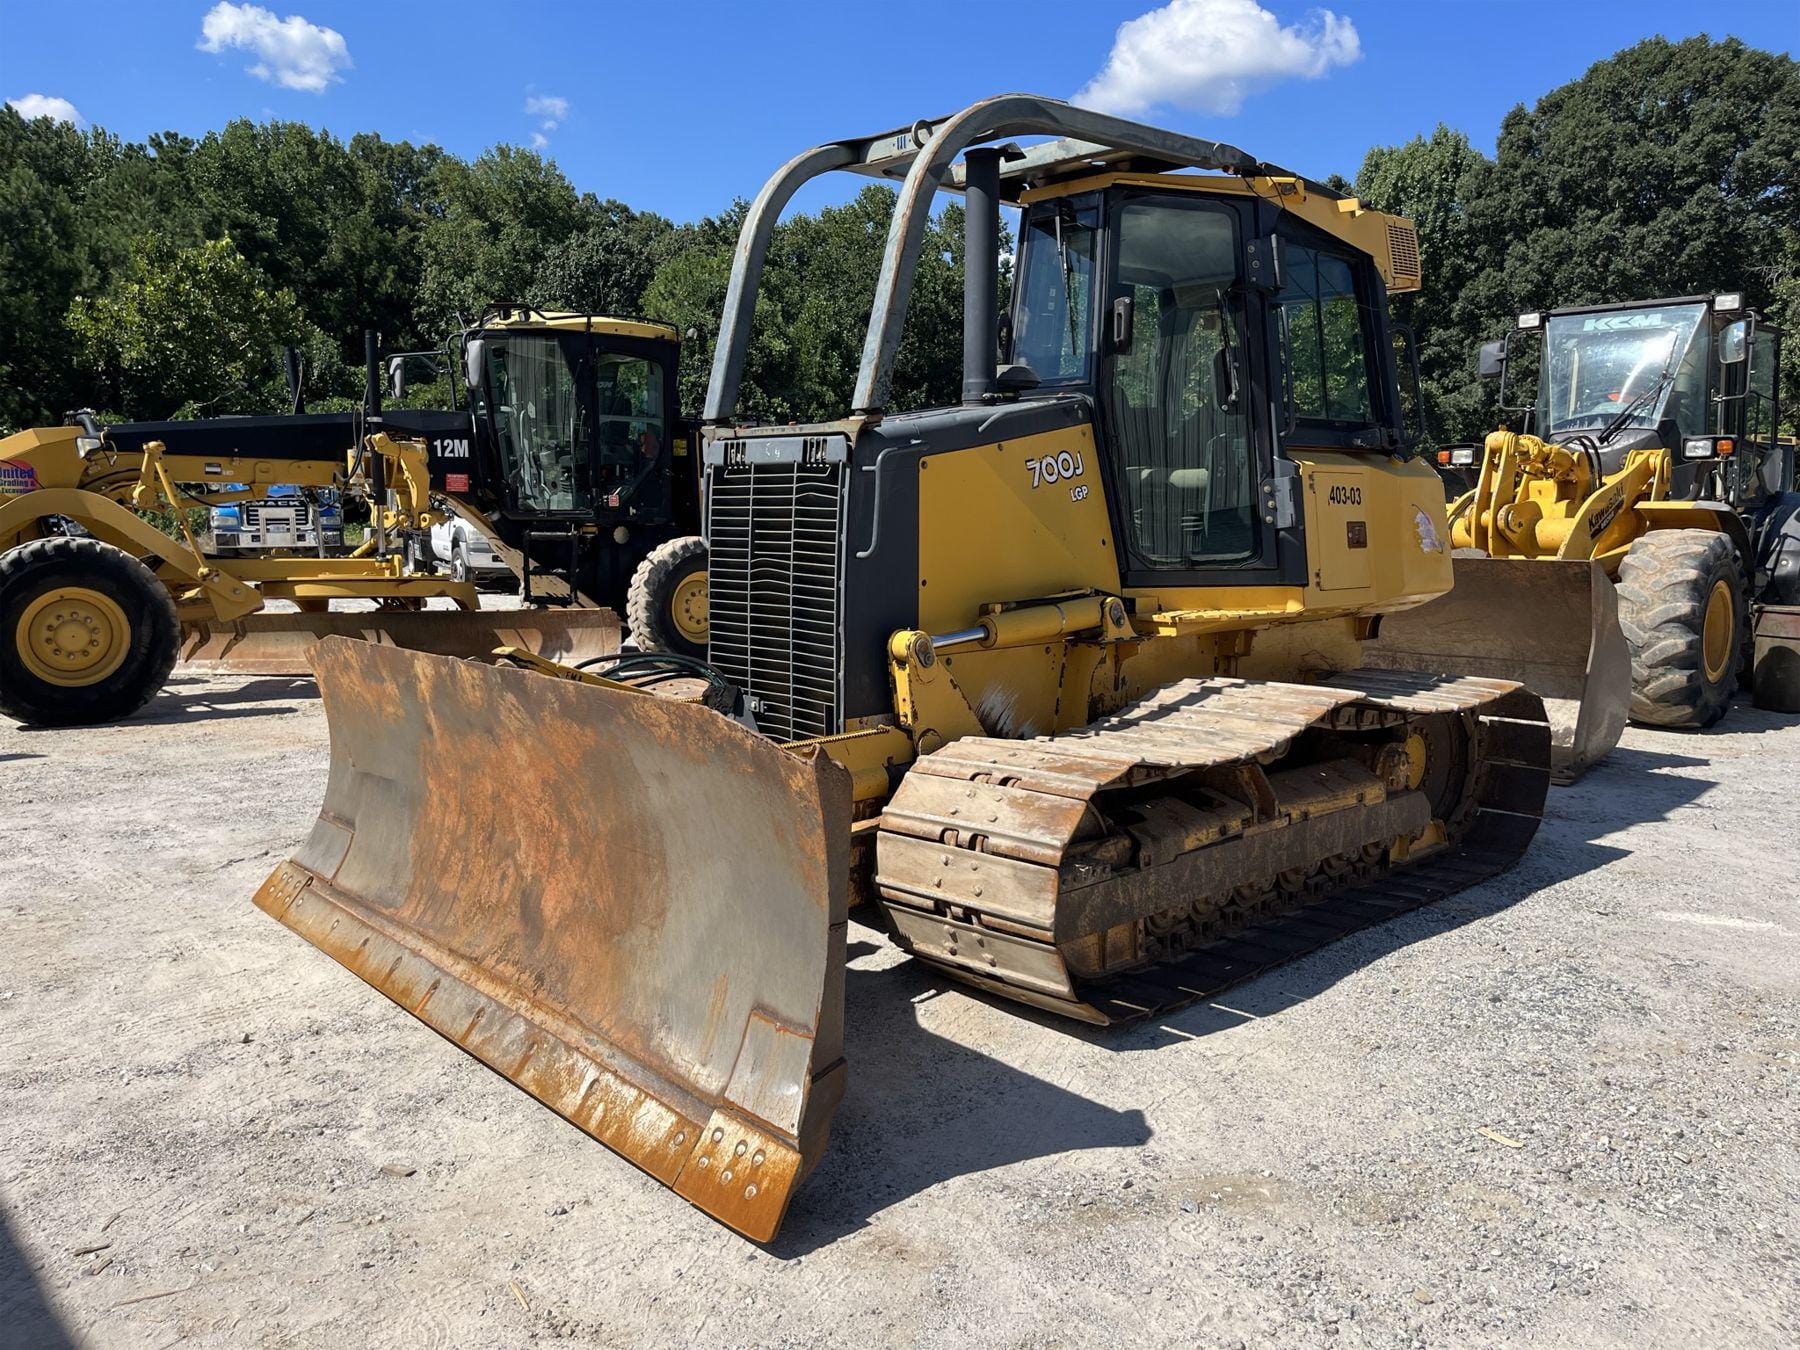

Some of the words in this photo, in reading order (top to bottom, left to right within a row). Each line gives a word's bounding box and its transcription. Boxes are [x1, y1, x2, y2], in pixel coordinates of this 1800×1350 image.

[1583, 314, 1662, 331] KCM
[433, 439, 469, 458] 12M
[0, 467, 34, 478] nited
[1025, 450, 1084, 489] 700J
[1070, 485, 1088, 502] LGP
[1330, 486, 1361, 505] 403-03
[1588, 482, 1624, 531] Kawasaki
